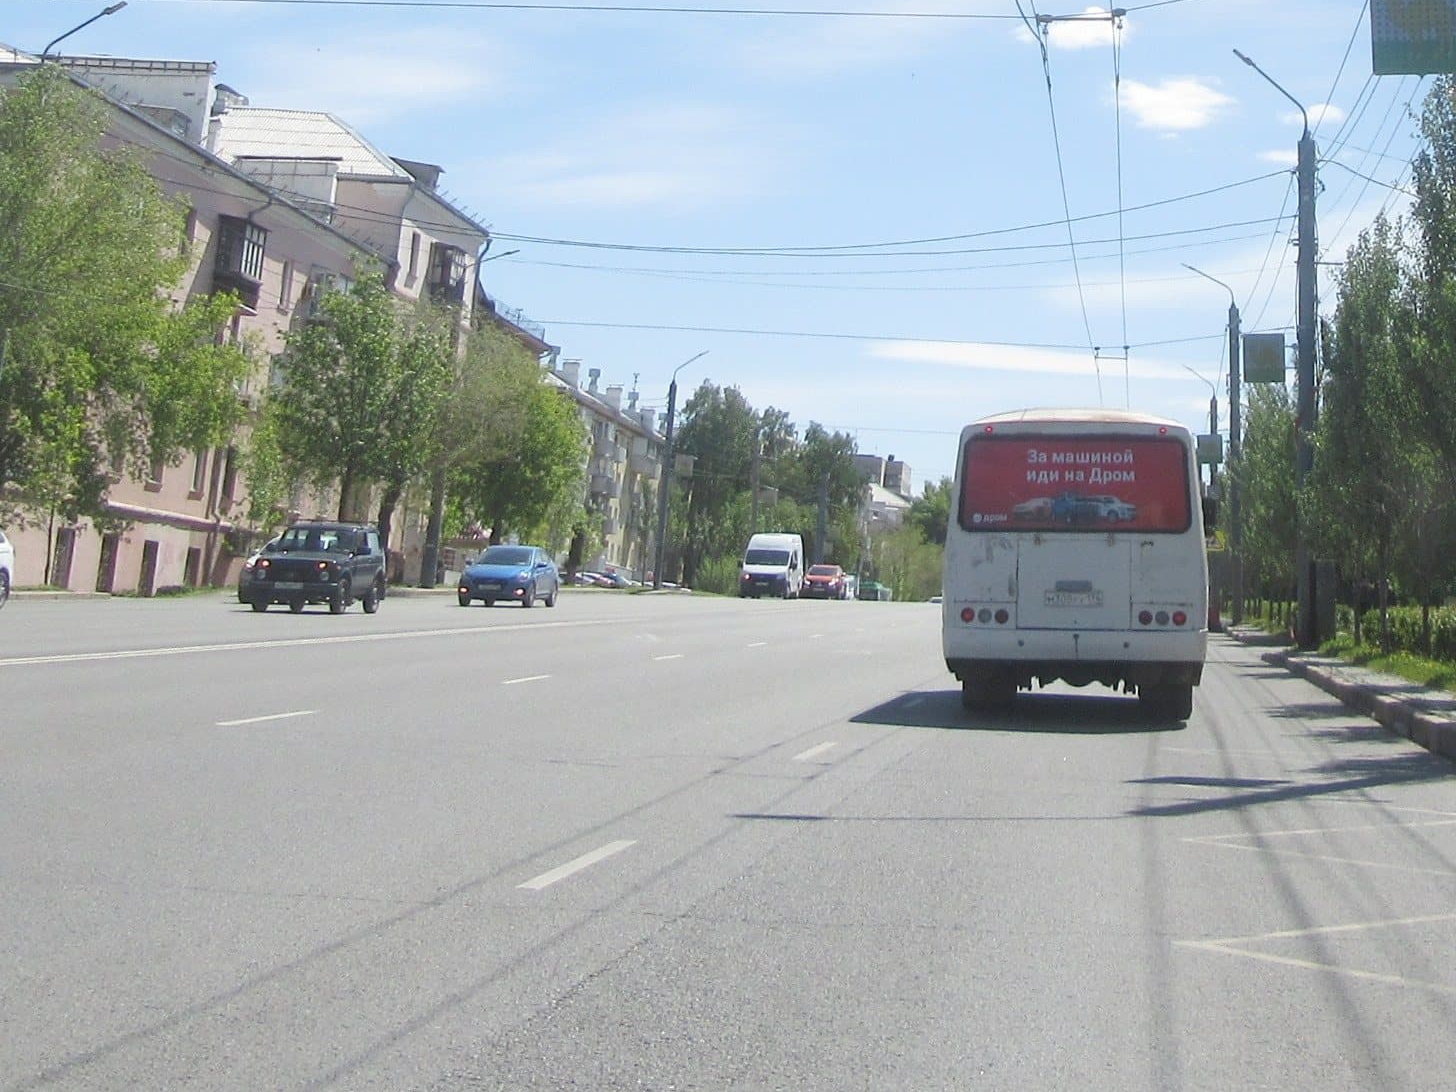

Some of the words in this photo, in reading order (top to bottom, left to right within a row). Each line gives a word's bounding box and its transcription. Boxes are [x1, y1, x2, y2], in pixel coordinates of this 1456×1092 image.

[1027, 449, 1048, 463] За
[1052, 449, 1134, 463] машиной
[1026, 469, 1060, 484] иди
[1064, 469, 1085, 481] на
[1088, 467, 1136, 484] Дром
